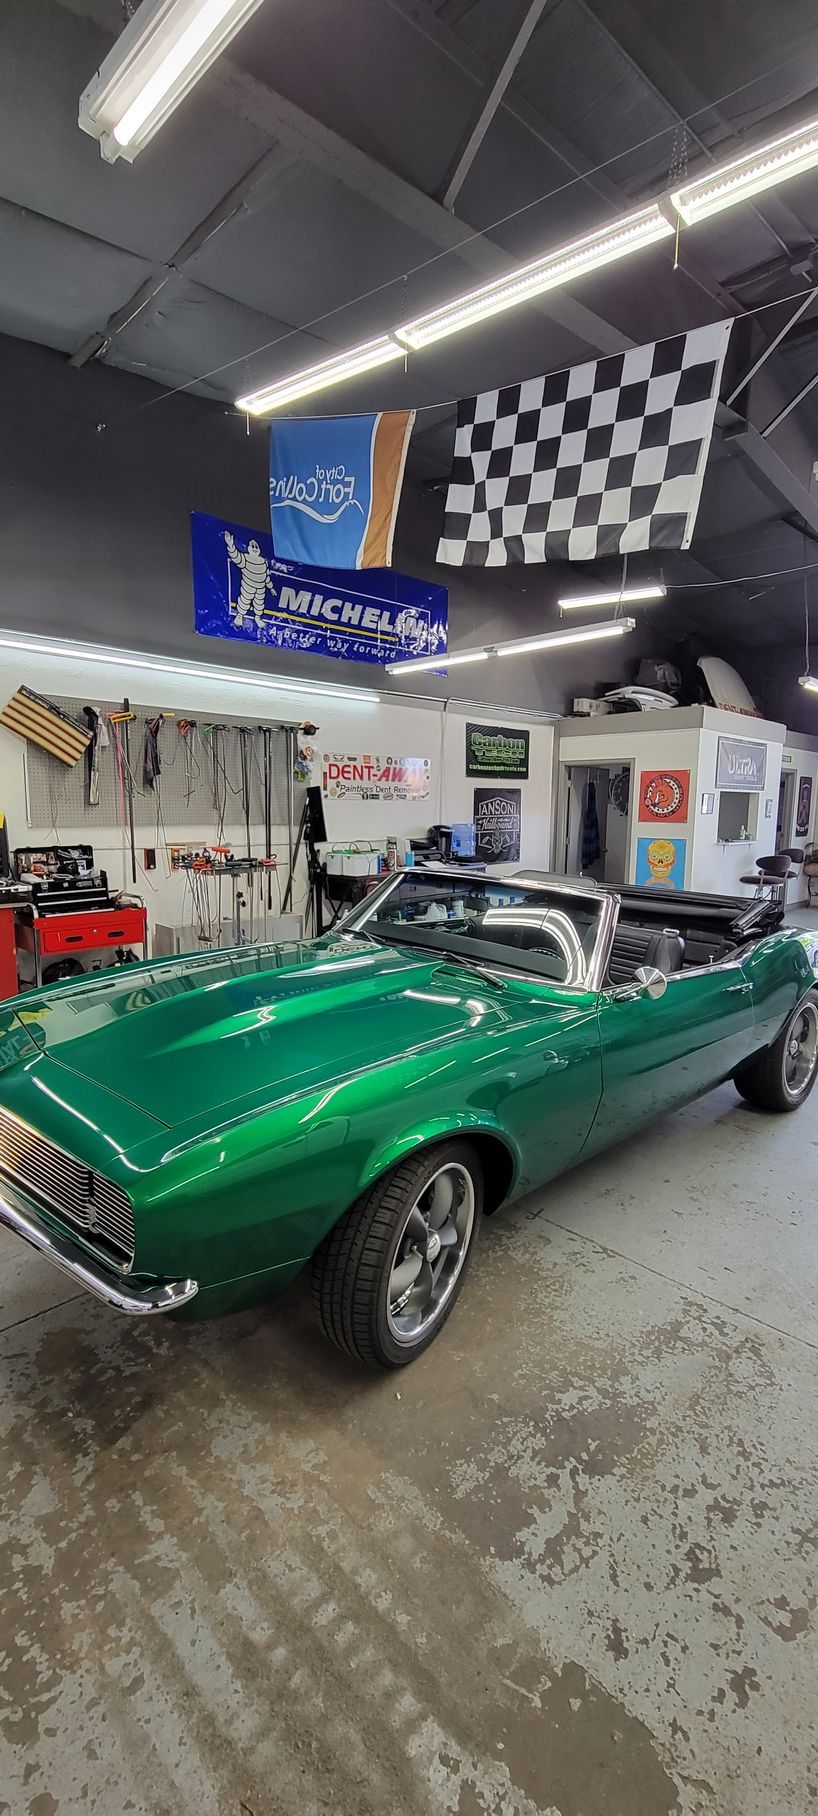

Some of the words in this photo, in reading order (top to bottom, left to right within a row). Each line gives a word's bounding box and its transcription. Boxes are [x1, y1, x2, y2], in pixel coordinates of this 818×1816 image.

[277, 586, 426, 638] MICHELIN
[269, 626, 277, 636] A
[283, 629, 322, 645] better
[326, 638, 350, 651] way
[352, 641, 397, 659] forward
[471, 733, 525, 750] Carbon
[340, 784, 374, 794] Paintless
[376, 785, 391, 795] Dent
[393, 786, 421, 796] Removal
[481, 799, 515, 815] ANSON
